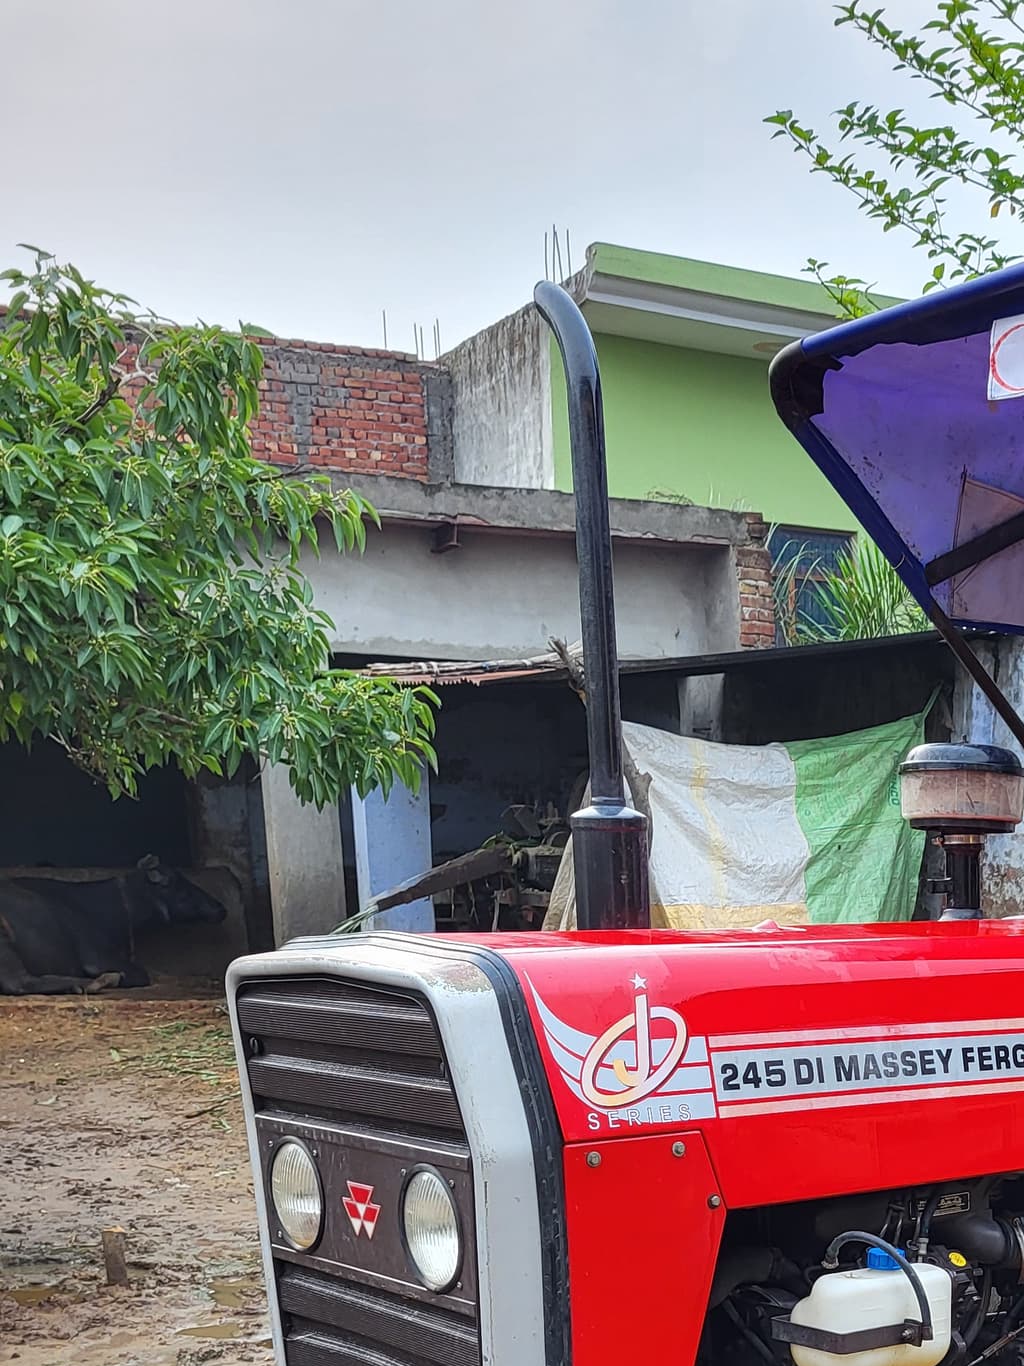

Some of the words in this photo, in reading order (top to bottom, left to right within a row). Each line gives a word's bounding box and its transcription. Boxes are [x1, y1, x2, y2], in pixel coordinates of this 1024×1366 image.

[720, 1059, 787, 1091] 245
[793, 1056, 825, 1086] DI
[834, 1048, 953, 1083] MASSEY
[587, 1103, 692, 1131] SERIES
